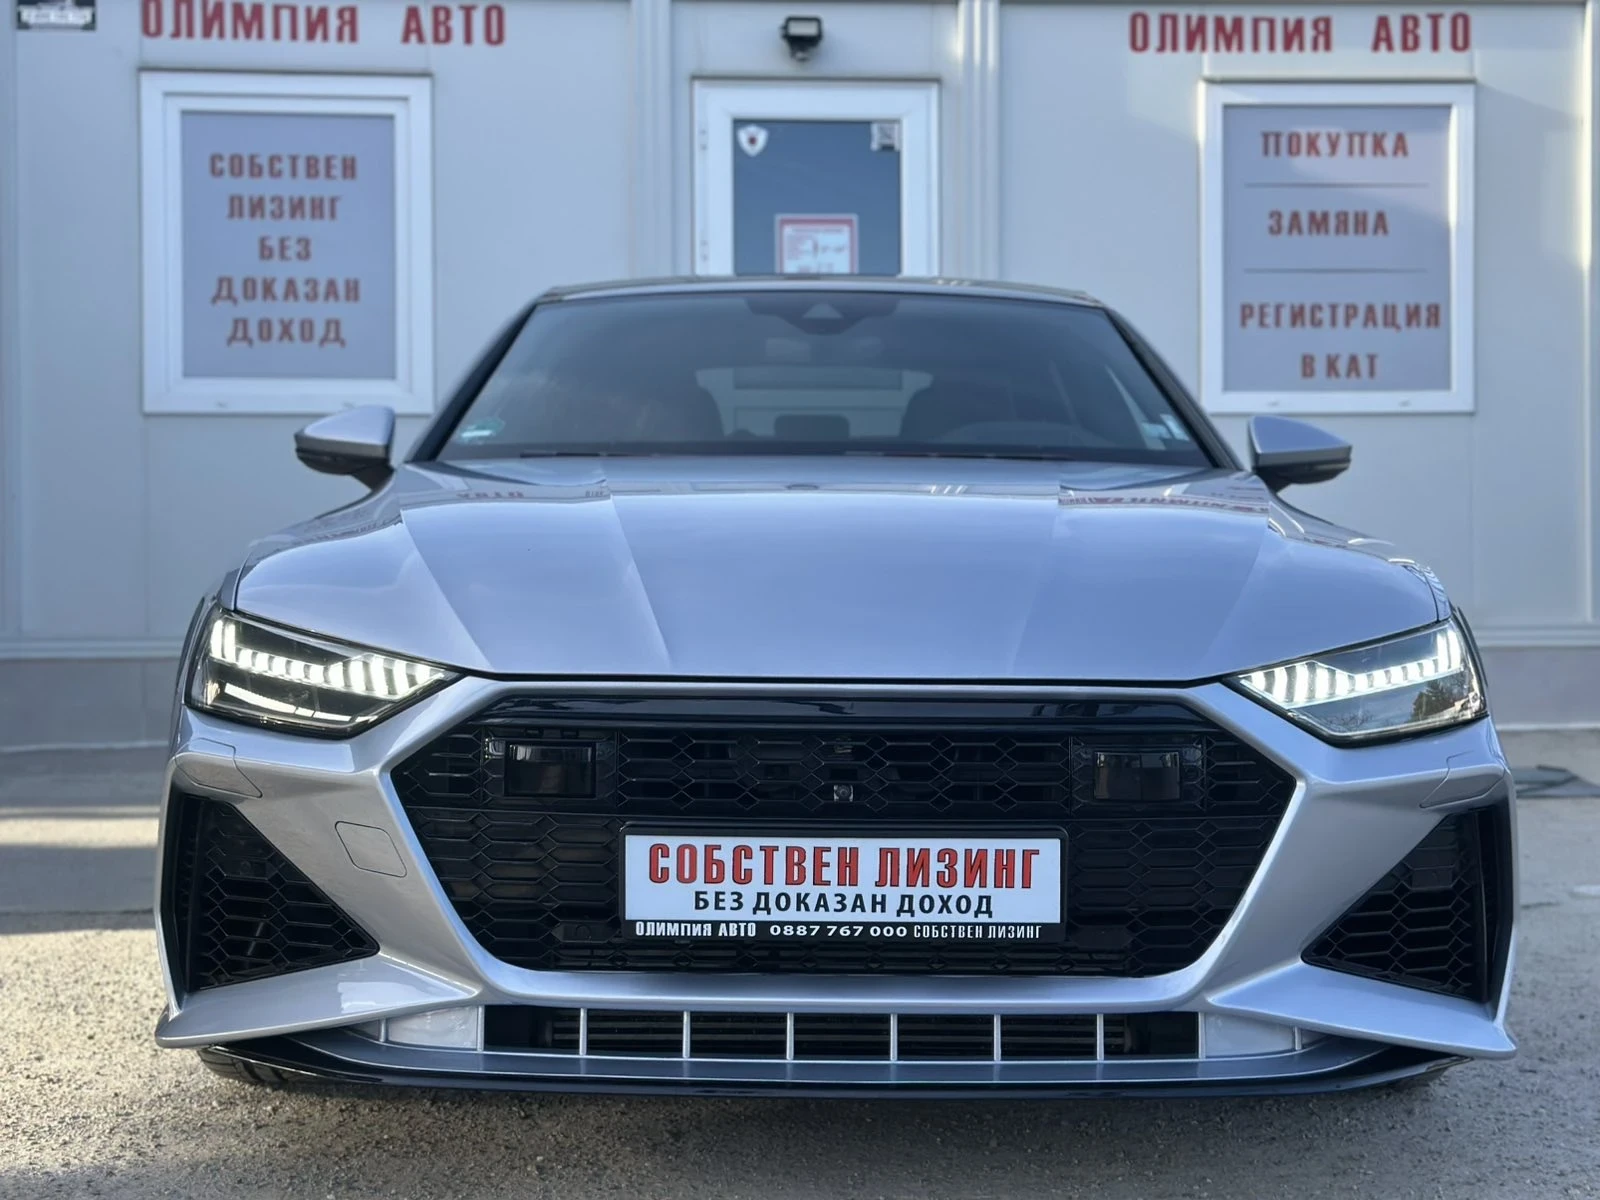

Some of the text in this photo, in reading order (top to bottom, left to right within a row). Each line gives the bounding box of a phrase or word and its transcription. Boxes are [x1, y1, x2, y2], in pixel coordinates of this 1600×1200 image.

[141, 0, 359, 44] ОЛИМПИЯ
[400, 4, 507, 46] АВТО
[1129, 12, 1471, 53] ОЛИМПИЯ АВТО
[1262, 131, 1409, 158] ПОКУПКА
[209, 154, 357, 181] СОБСТВЕН
[227, 195, 339, 221] ЛИЗИНГ
[1267, 210, 1389, 236] ЗАМЯНА
[258, 236, 312, 262] БЕЗ
[211, 276, 360, 305] ДОКАЗАН
[1240, 303, 1441, 332] РЕГИСТРАЦИЯ
[227, 317, 346, 348] ДОХОД
[1301, 354, 1378, 379] В КАТ
[648, 843, 1040, 889] СОБСТВЕН ЛИЗИНГ
[694, 890, 993, 918] БЕЗ ДОКАЗАН ДОХОД
[635, 922, 1042, 939] ОЛИМПИЯ АВТО 0887 767 000 СОБСТВЕН ЛИЗИНГ
